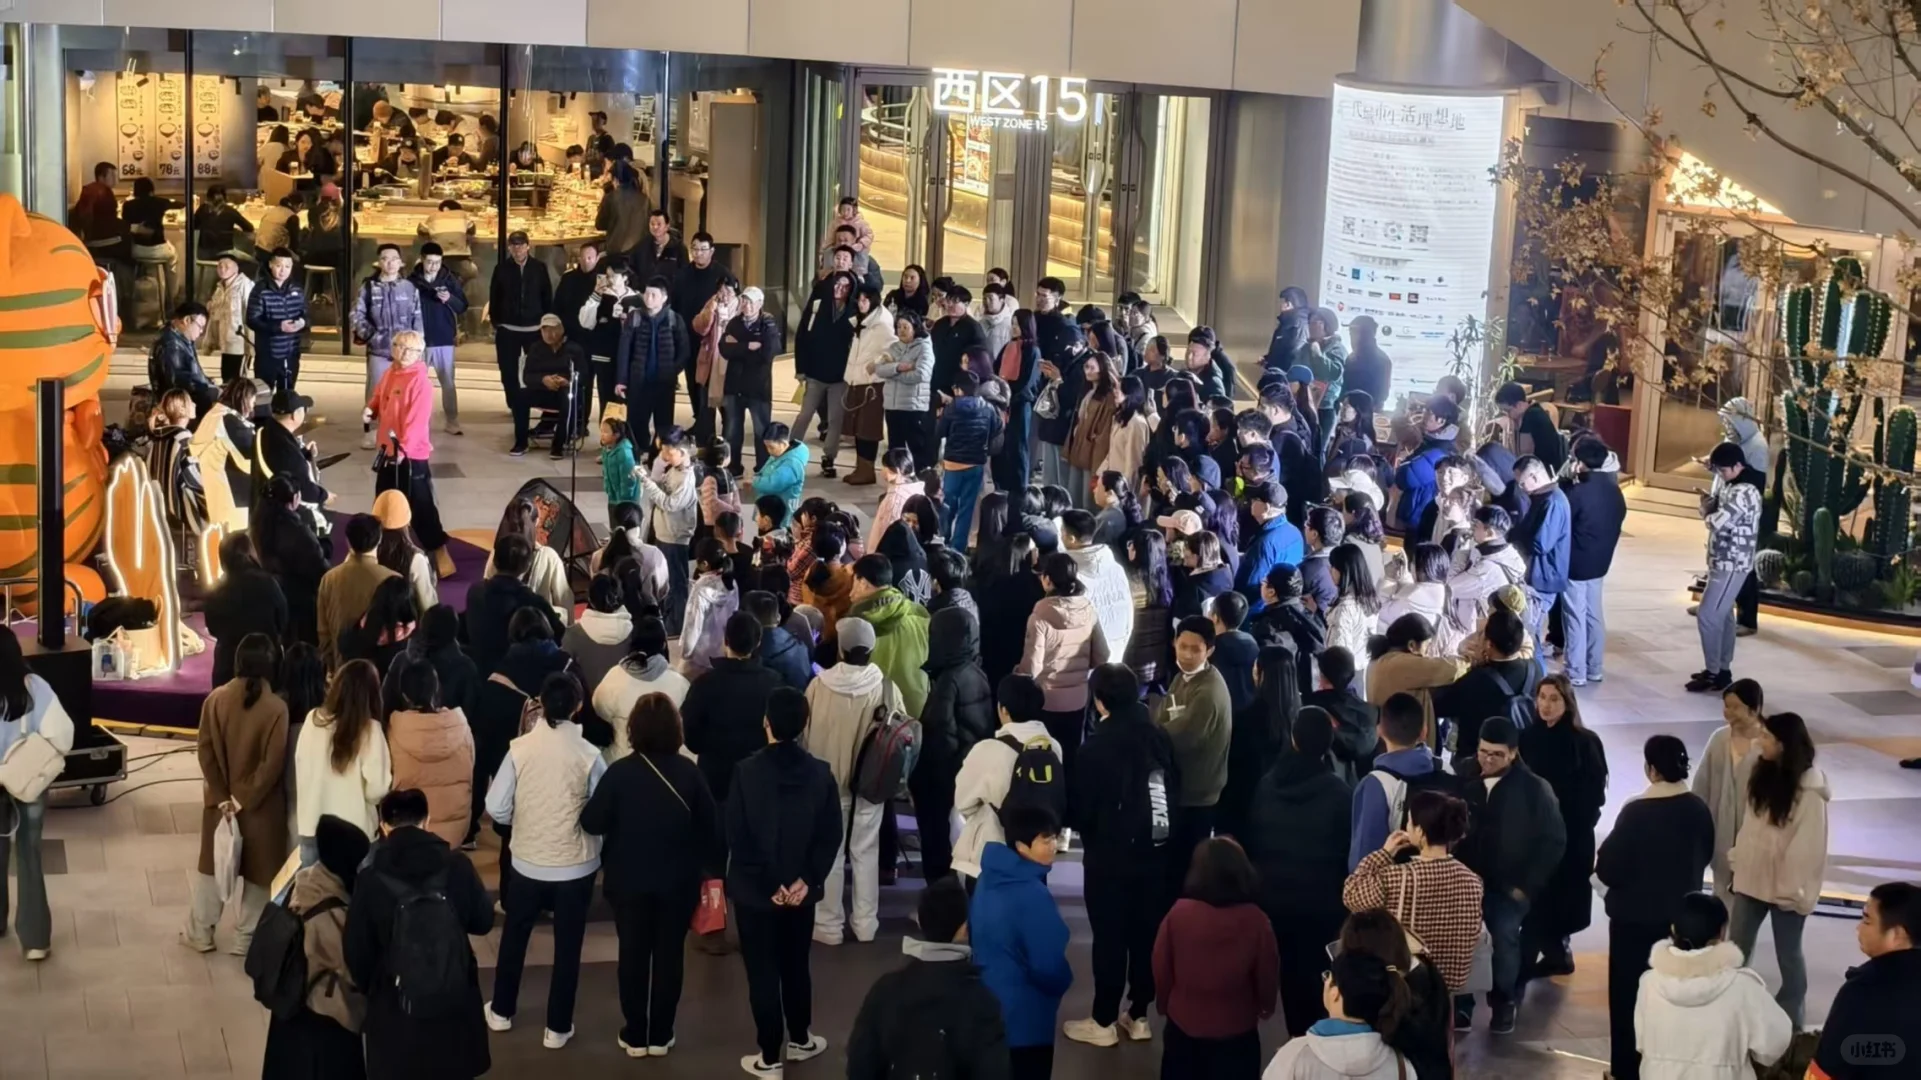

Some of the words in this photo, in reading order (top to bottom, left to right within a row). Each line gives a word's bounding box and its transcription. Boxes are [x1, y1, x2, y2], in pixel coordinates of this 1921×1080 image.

[932, 67, 1088, 122] 西区15
[970, 115, 1001, 128] WEST
[1003, 117, 1034, 130] ZONE
[1035, 119, 1048, 131] 15
[1148, 782, 1170, 827] NIKE
